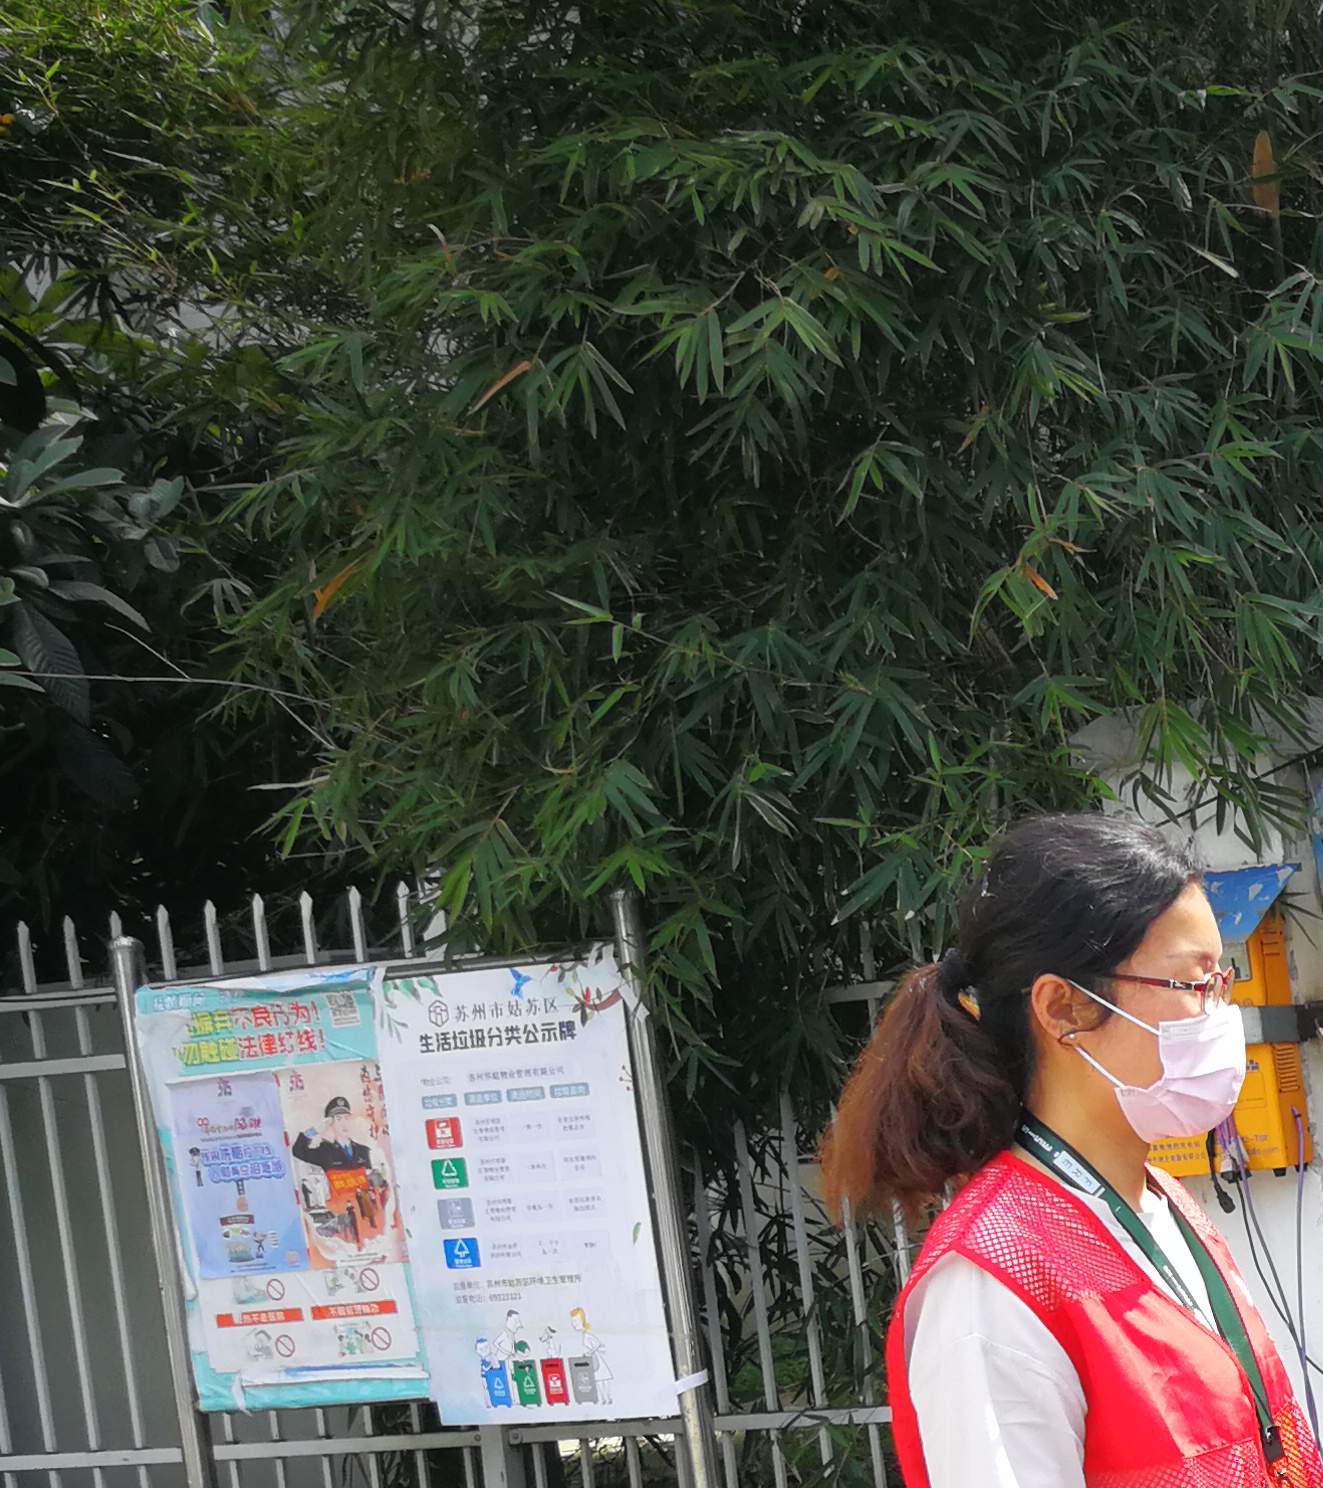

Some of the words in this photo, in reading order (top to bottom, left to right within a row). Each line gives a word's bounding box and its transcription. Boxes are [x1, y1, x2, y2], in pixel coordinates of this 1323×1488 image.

[455, 995, 558, 1023] 苏州市姑苏区
[420, 1020, 577, 1053] 生活垃圾分类公示牌
